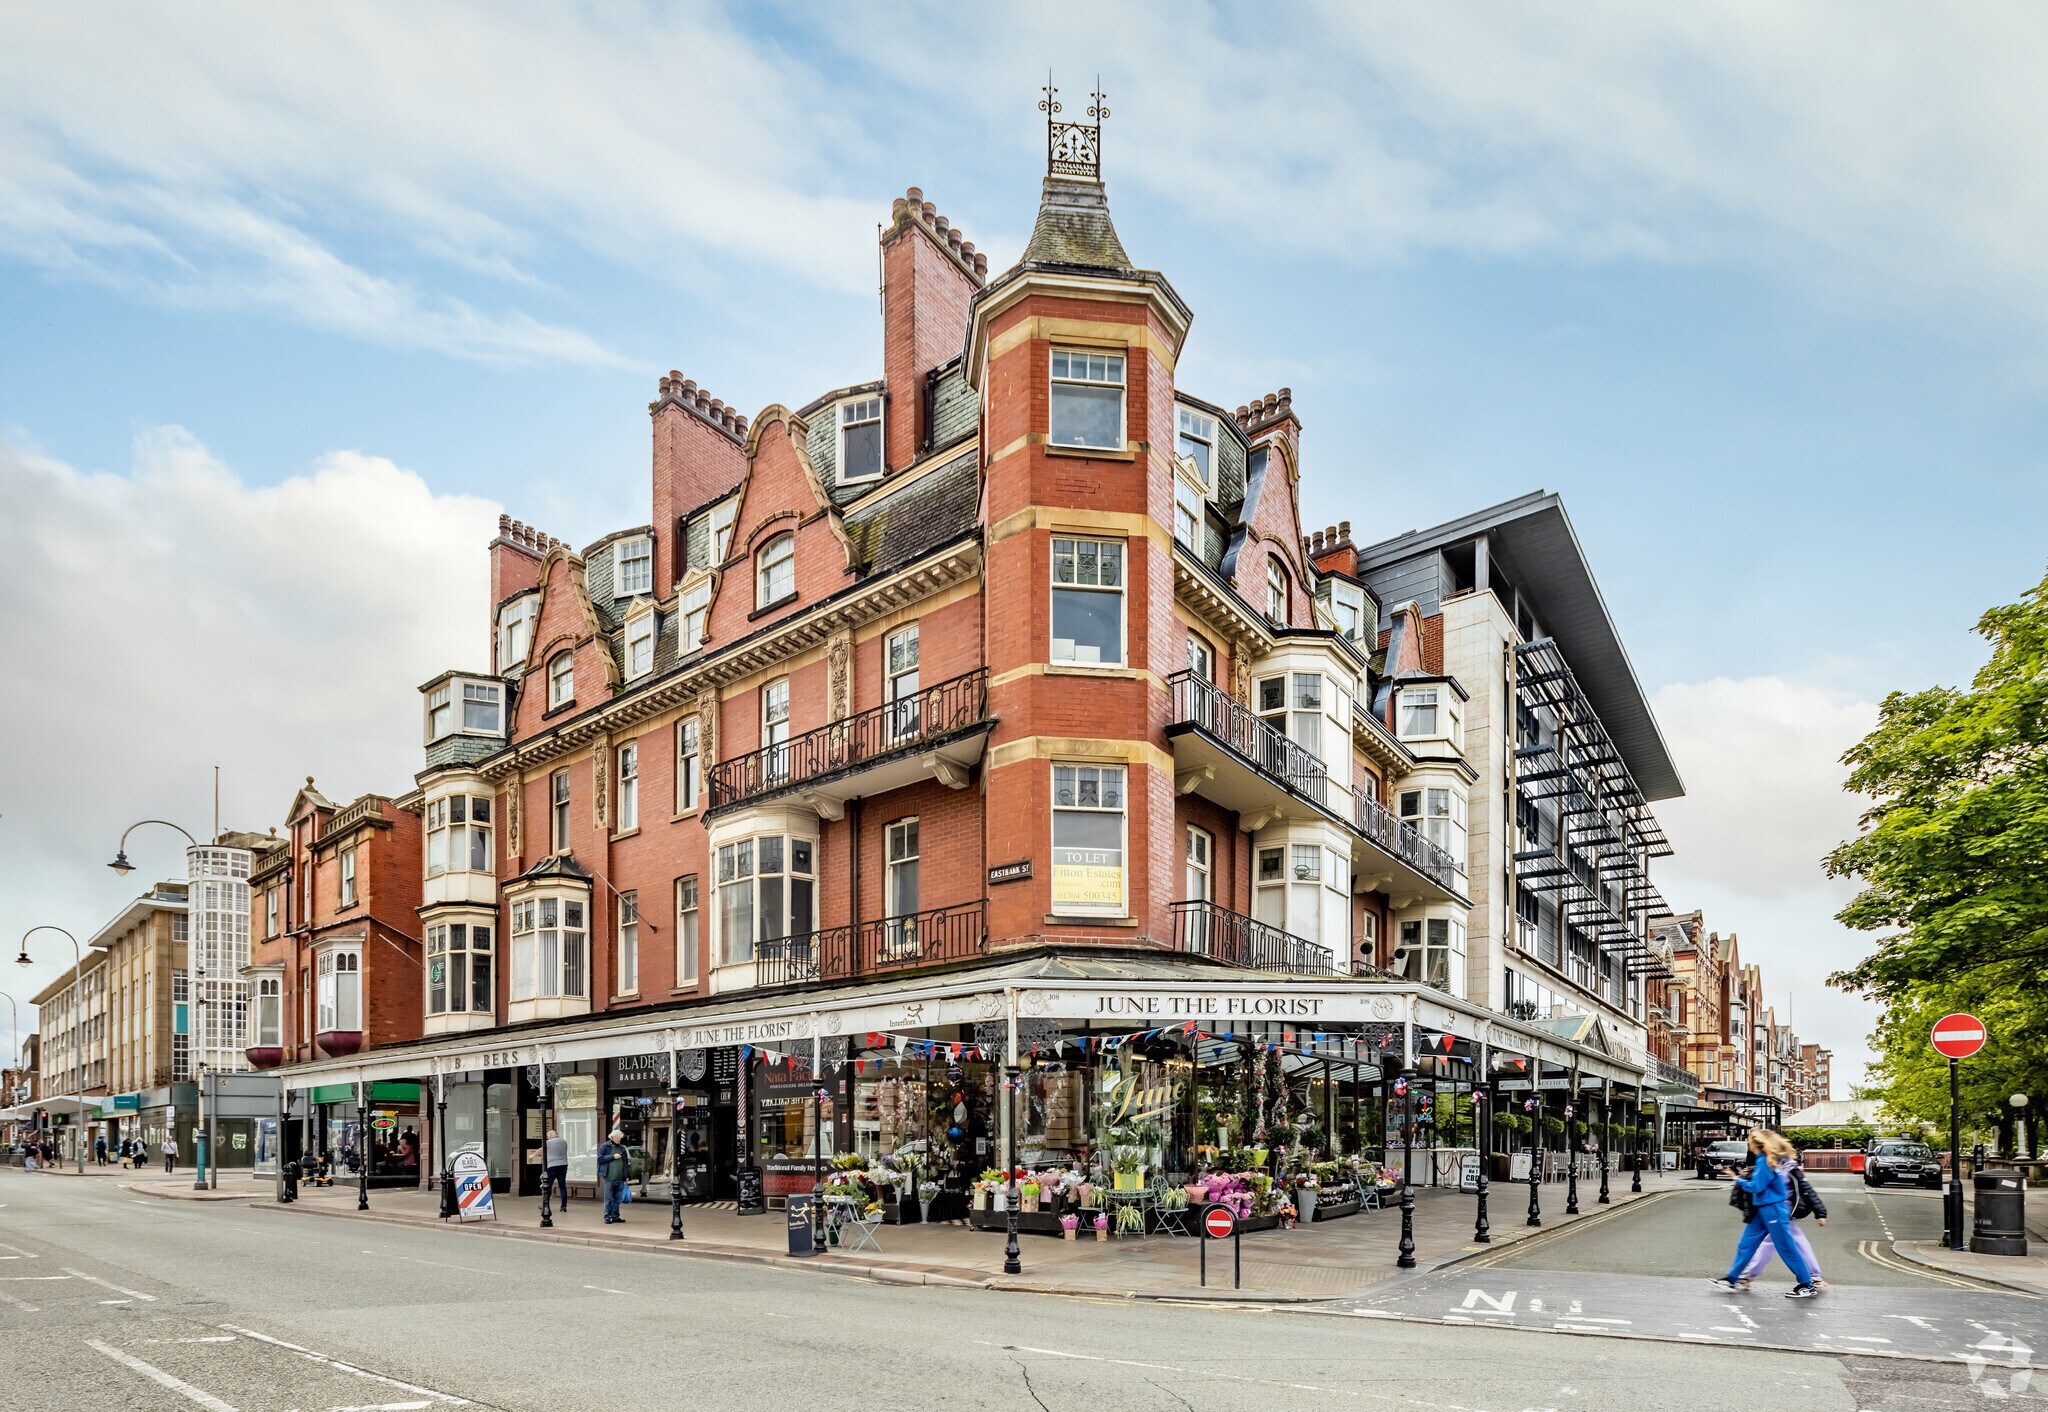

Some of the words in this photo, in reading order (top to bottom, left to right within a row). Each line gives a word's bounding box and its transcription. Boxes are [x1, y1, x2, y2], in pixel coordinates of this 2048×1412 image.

[1065, 852, 1082, 863] TO
[1085, 852, 1108, 864] LET
[990, 867, 1020, 879] EASTBANK
[1053, 867, 1083, 878] Fitton
[1086, 867, 1122, 879] Estates
[1098, 880, 1121, 889] .com
[1083, 891, 1117, 901] 500345
[1095, 996, 1160, 1015] JUNE
[1168, 997, 1218, 1015] THE
[1226, 998, 1324, 1016] FLORIST
[889, 1017, 916, 1028] Interflora
[695, 1029, 720, 1045] JUNE
[723, 1027, 744, 1043] THE
[748, 1021, 793, 1040] FLORIST
[618, 1055, 656, 1071] BLADE
[764, 1071, 787, 1084] Nata
[789, 1069, 829, 1082] Facty
[1103, 1072, 1187, 1129] June
[370, 1109, 398, 1117] SUBWAY
[790, 1164, 807, 1173] Family
[464, 1183, 482, 1191] OPEN
